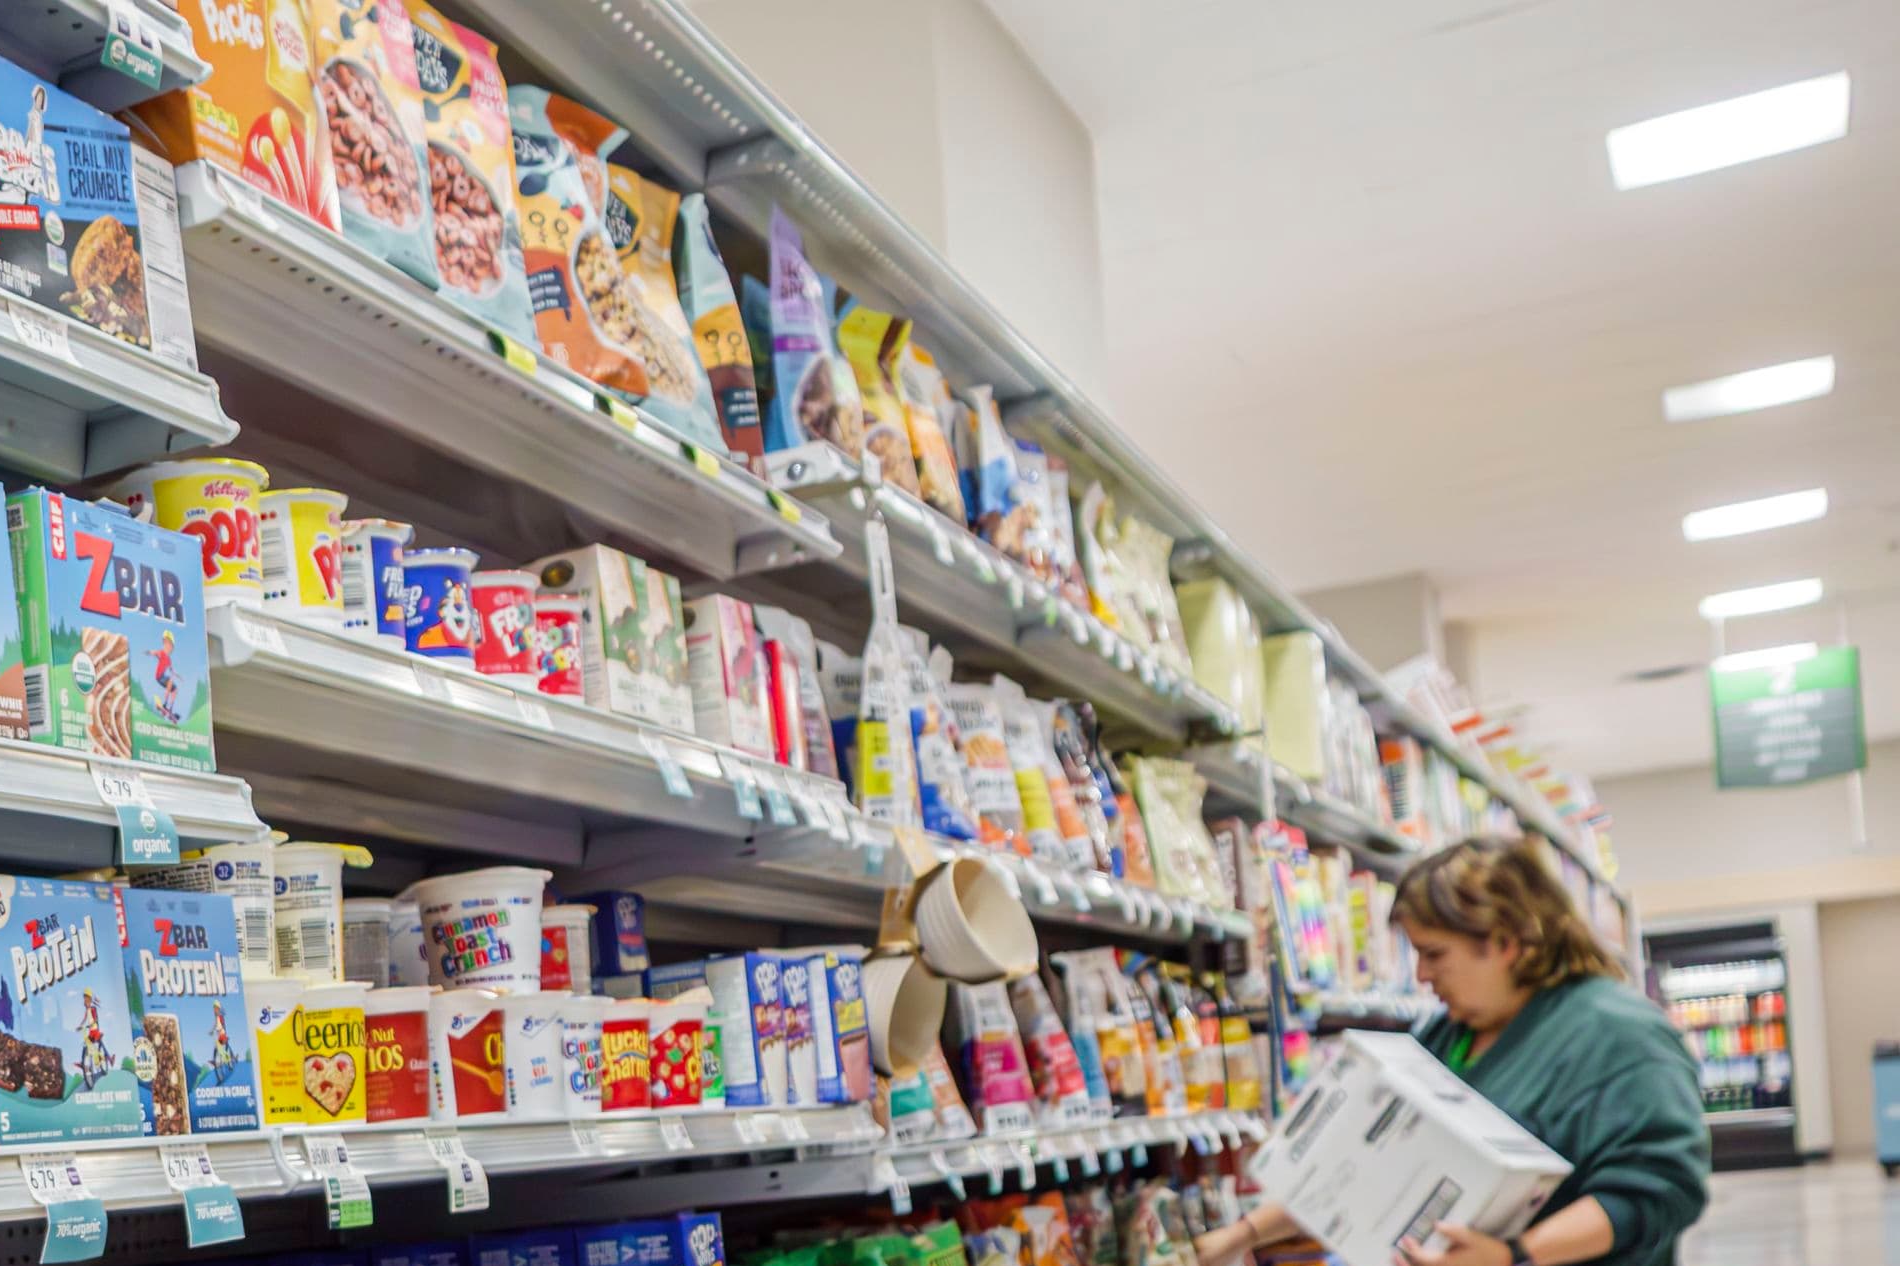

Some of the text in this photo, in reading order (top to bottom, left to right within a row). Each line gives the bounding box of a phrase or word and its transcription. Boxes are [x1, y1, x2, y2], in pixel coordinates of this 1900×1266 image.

[126, 51, 159, 77] organic
[66, 138, 126, 176] TRAIL MIX
[68, 165, 131, 203] CRUMBLE
[51, 497, 65, 557] CLIF
[100, 777, 132, 799] 6.79
[132, 836, 171, 858] organic
